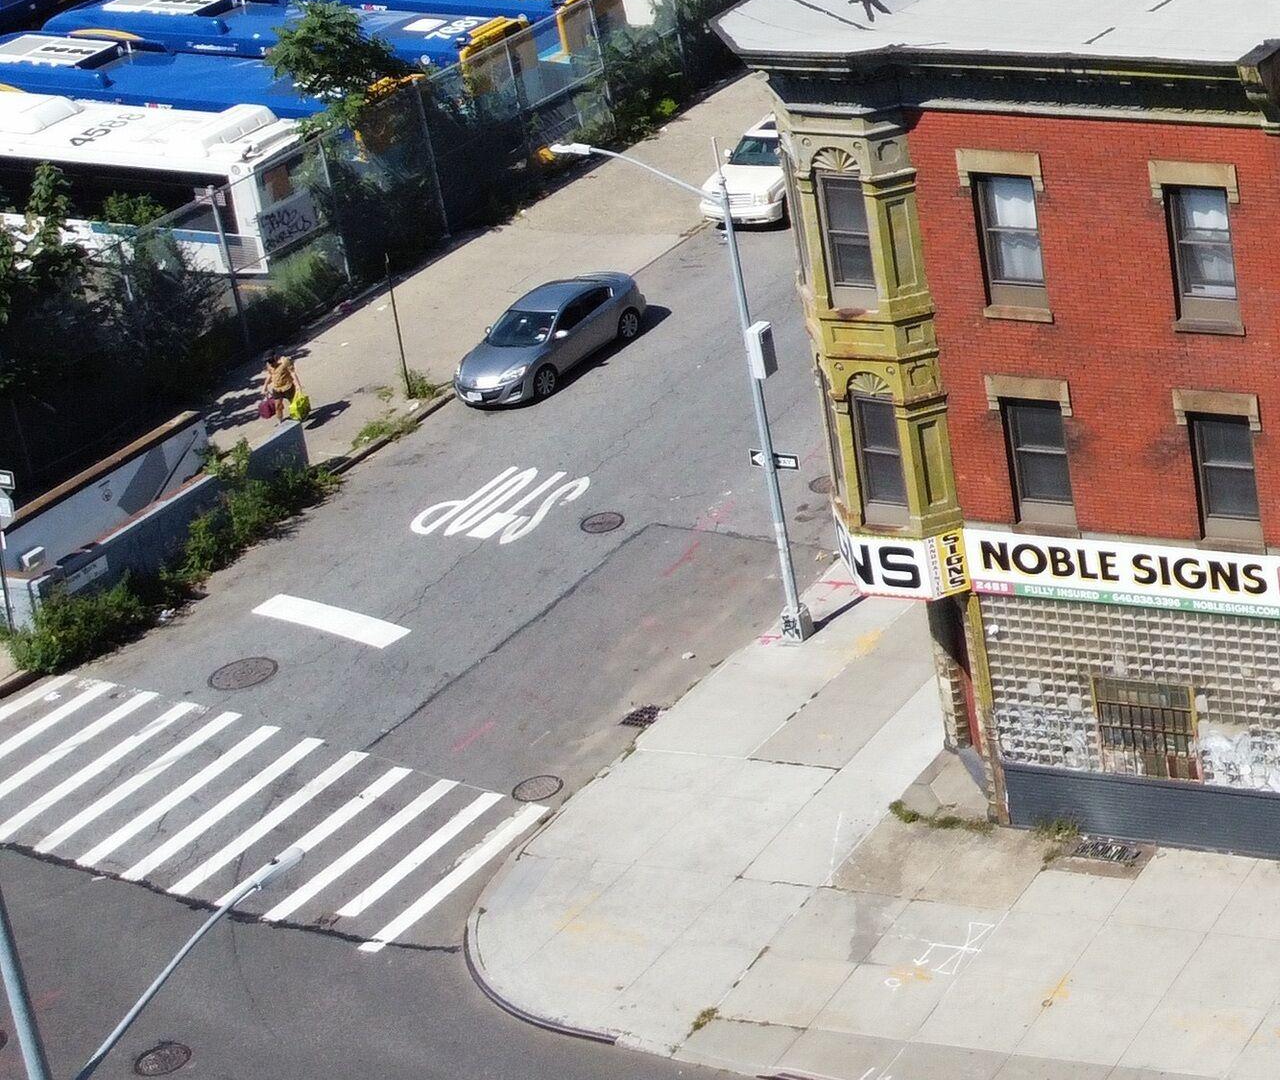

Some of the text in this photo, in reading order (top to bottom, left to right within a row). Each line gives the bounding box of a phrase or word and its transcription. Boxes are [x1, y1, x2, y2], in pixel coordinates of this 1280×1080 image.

[69, 112, 146, 148] 4588
[410, 466, 591, 545] STOP
[942, 532, 966, 588] SIGNS
[979, 540, 1268, 595] NOBLE SIGNS
[1024, 585, 1055, 597] FULLY
[1057, 587, 1100, 601] INSURED
[1193, 599, 1280, 617] NOBLESIGNS.COM
